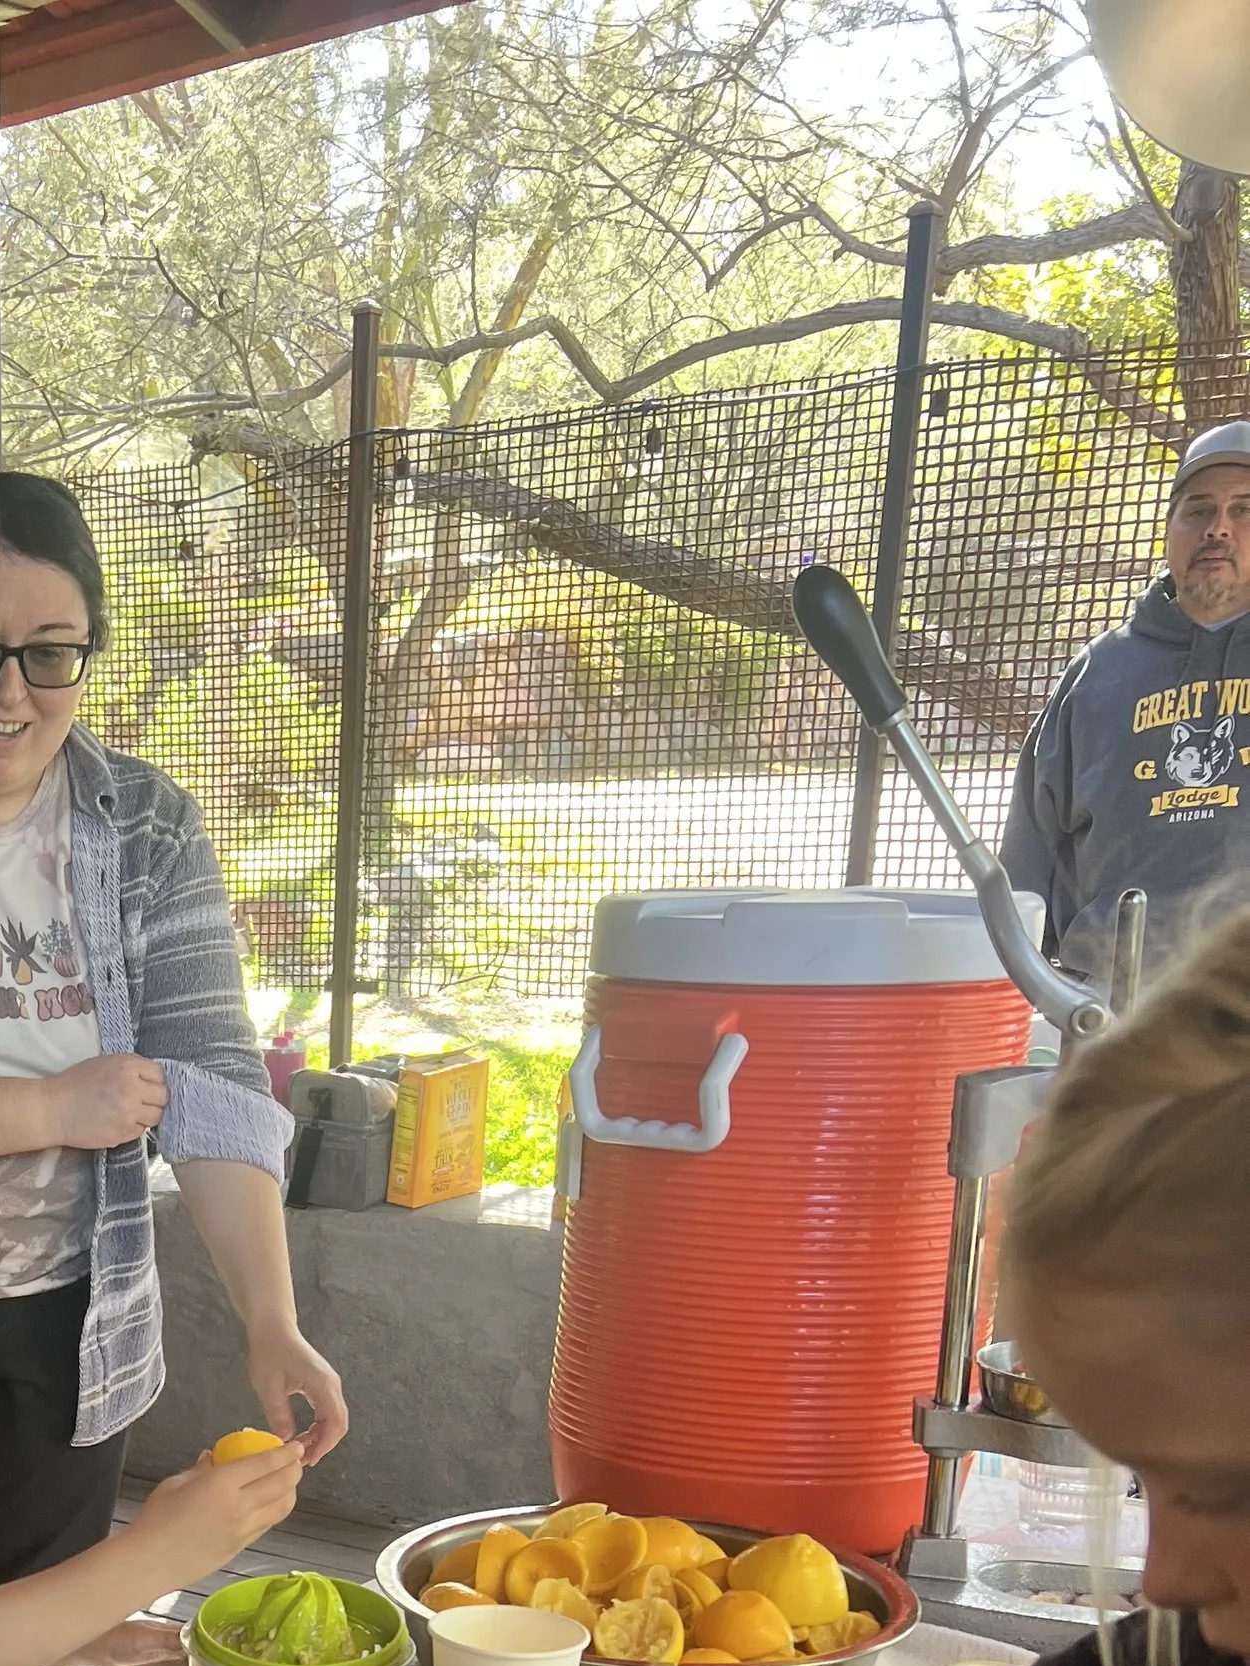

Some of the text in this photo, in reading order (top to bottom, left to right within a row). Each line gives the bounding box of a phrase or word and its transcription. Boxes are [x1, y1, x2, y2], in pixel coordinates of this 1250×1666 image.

[1133, 680, 1209, 734] GREAT
[1134, 760, 1157, 780] G
[1167, 789, 1222, 806] Lodge
[1168, 808, 1215, 824] ARIZONA
